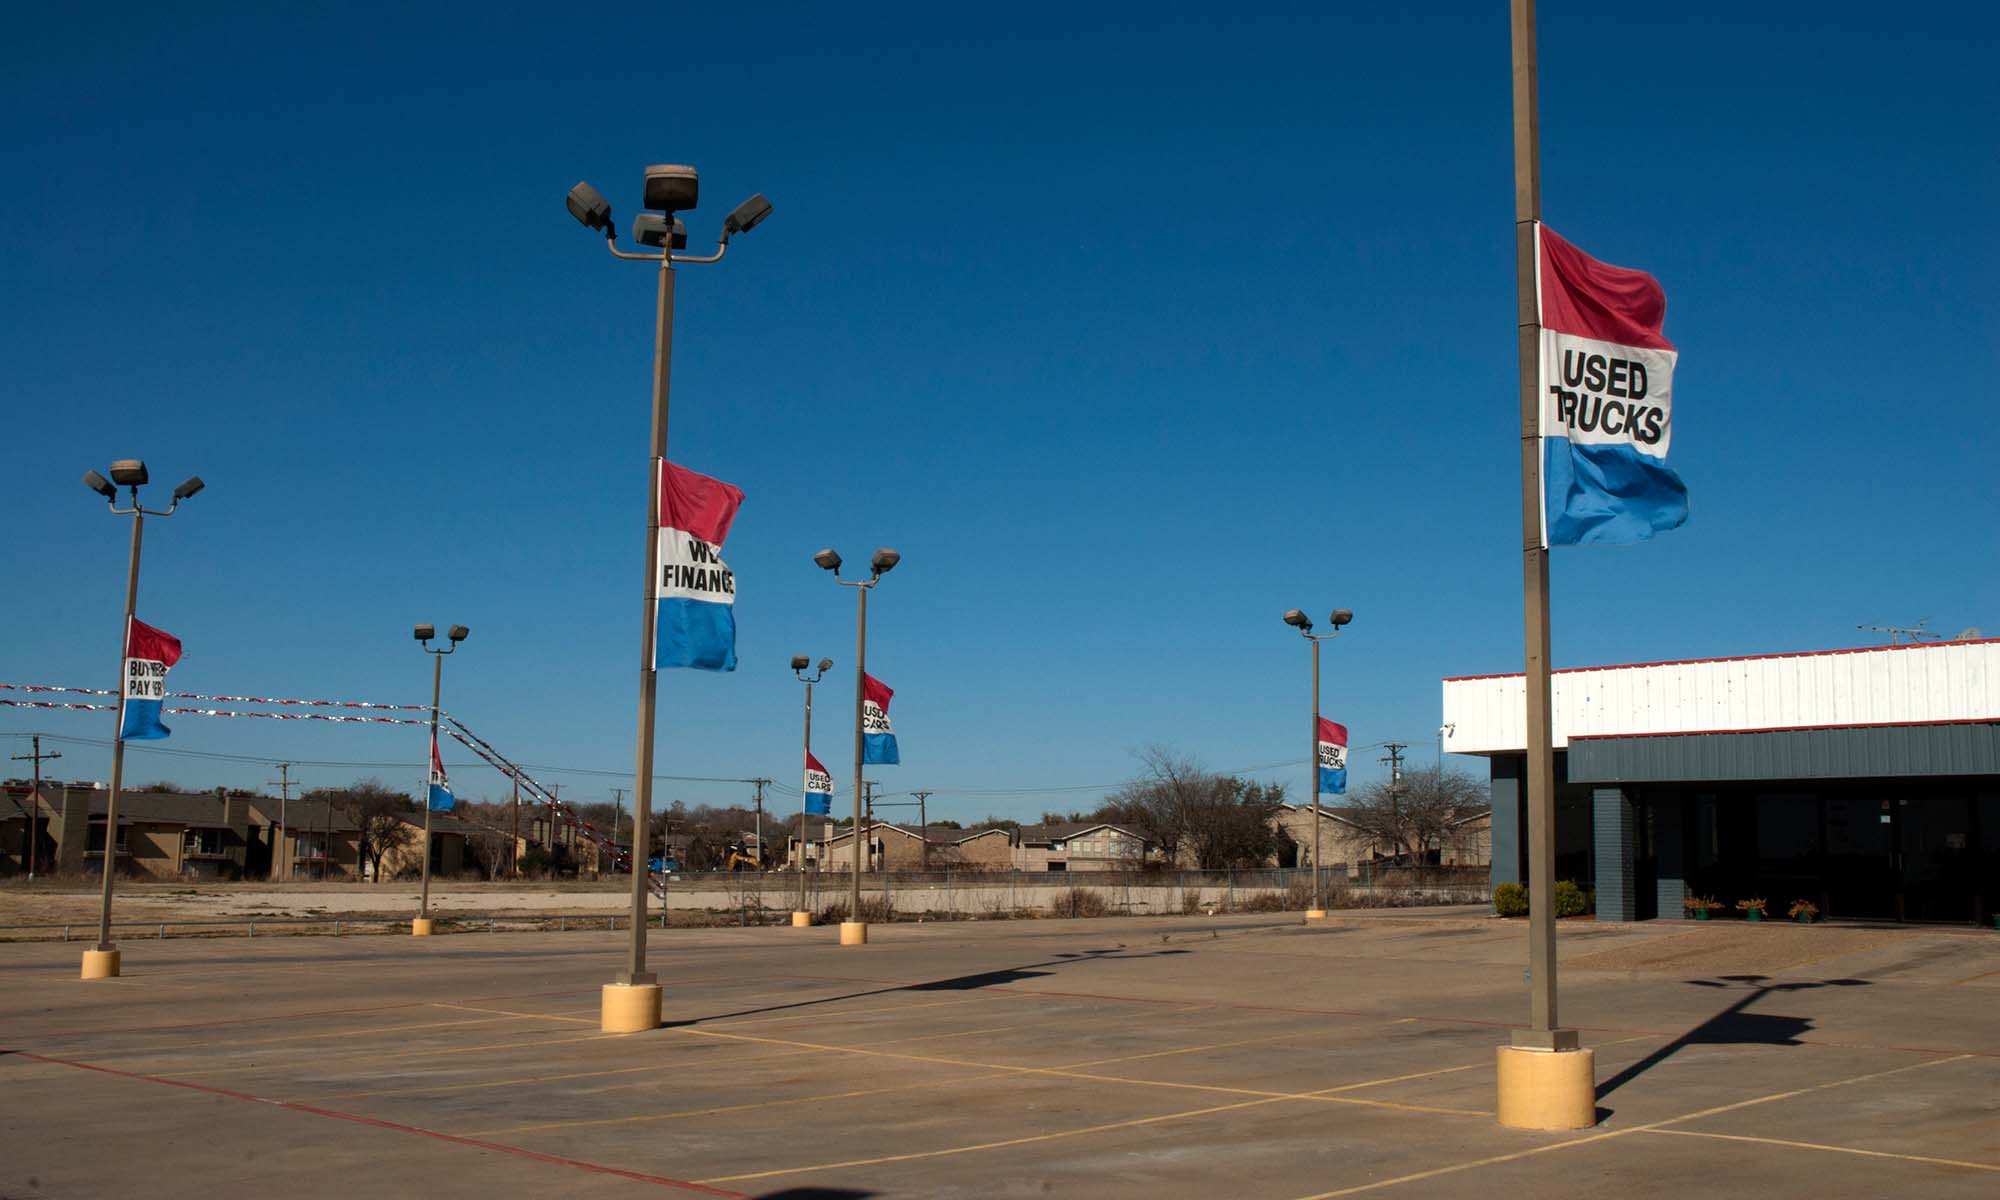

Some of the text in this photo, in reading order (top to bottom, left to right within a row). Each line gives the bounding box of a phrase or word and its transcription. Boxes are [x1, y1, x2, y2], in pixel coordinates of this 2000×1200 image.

[1564, 349, 1648, 400] USED
[1550, 385, 1664, 445] TRUCKS
[130, 660, 149, 676] BUY
[129, 680, 150, 696] PAY
[864, 704, 885, 719] USD
[863, 717, 890, 730] CARS
[1320, 744, 1340, 758] USED
[1319, 754, 1345, 768] RUCKS
[809, 771, 830, 783] USED
[808, 781, 831, 791] CARS
